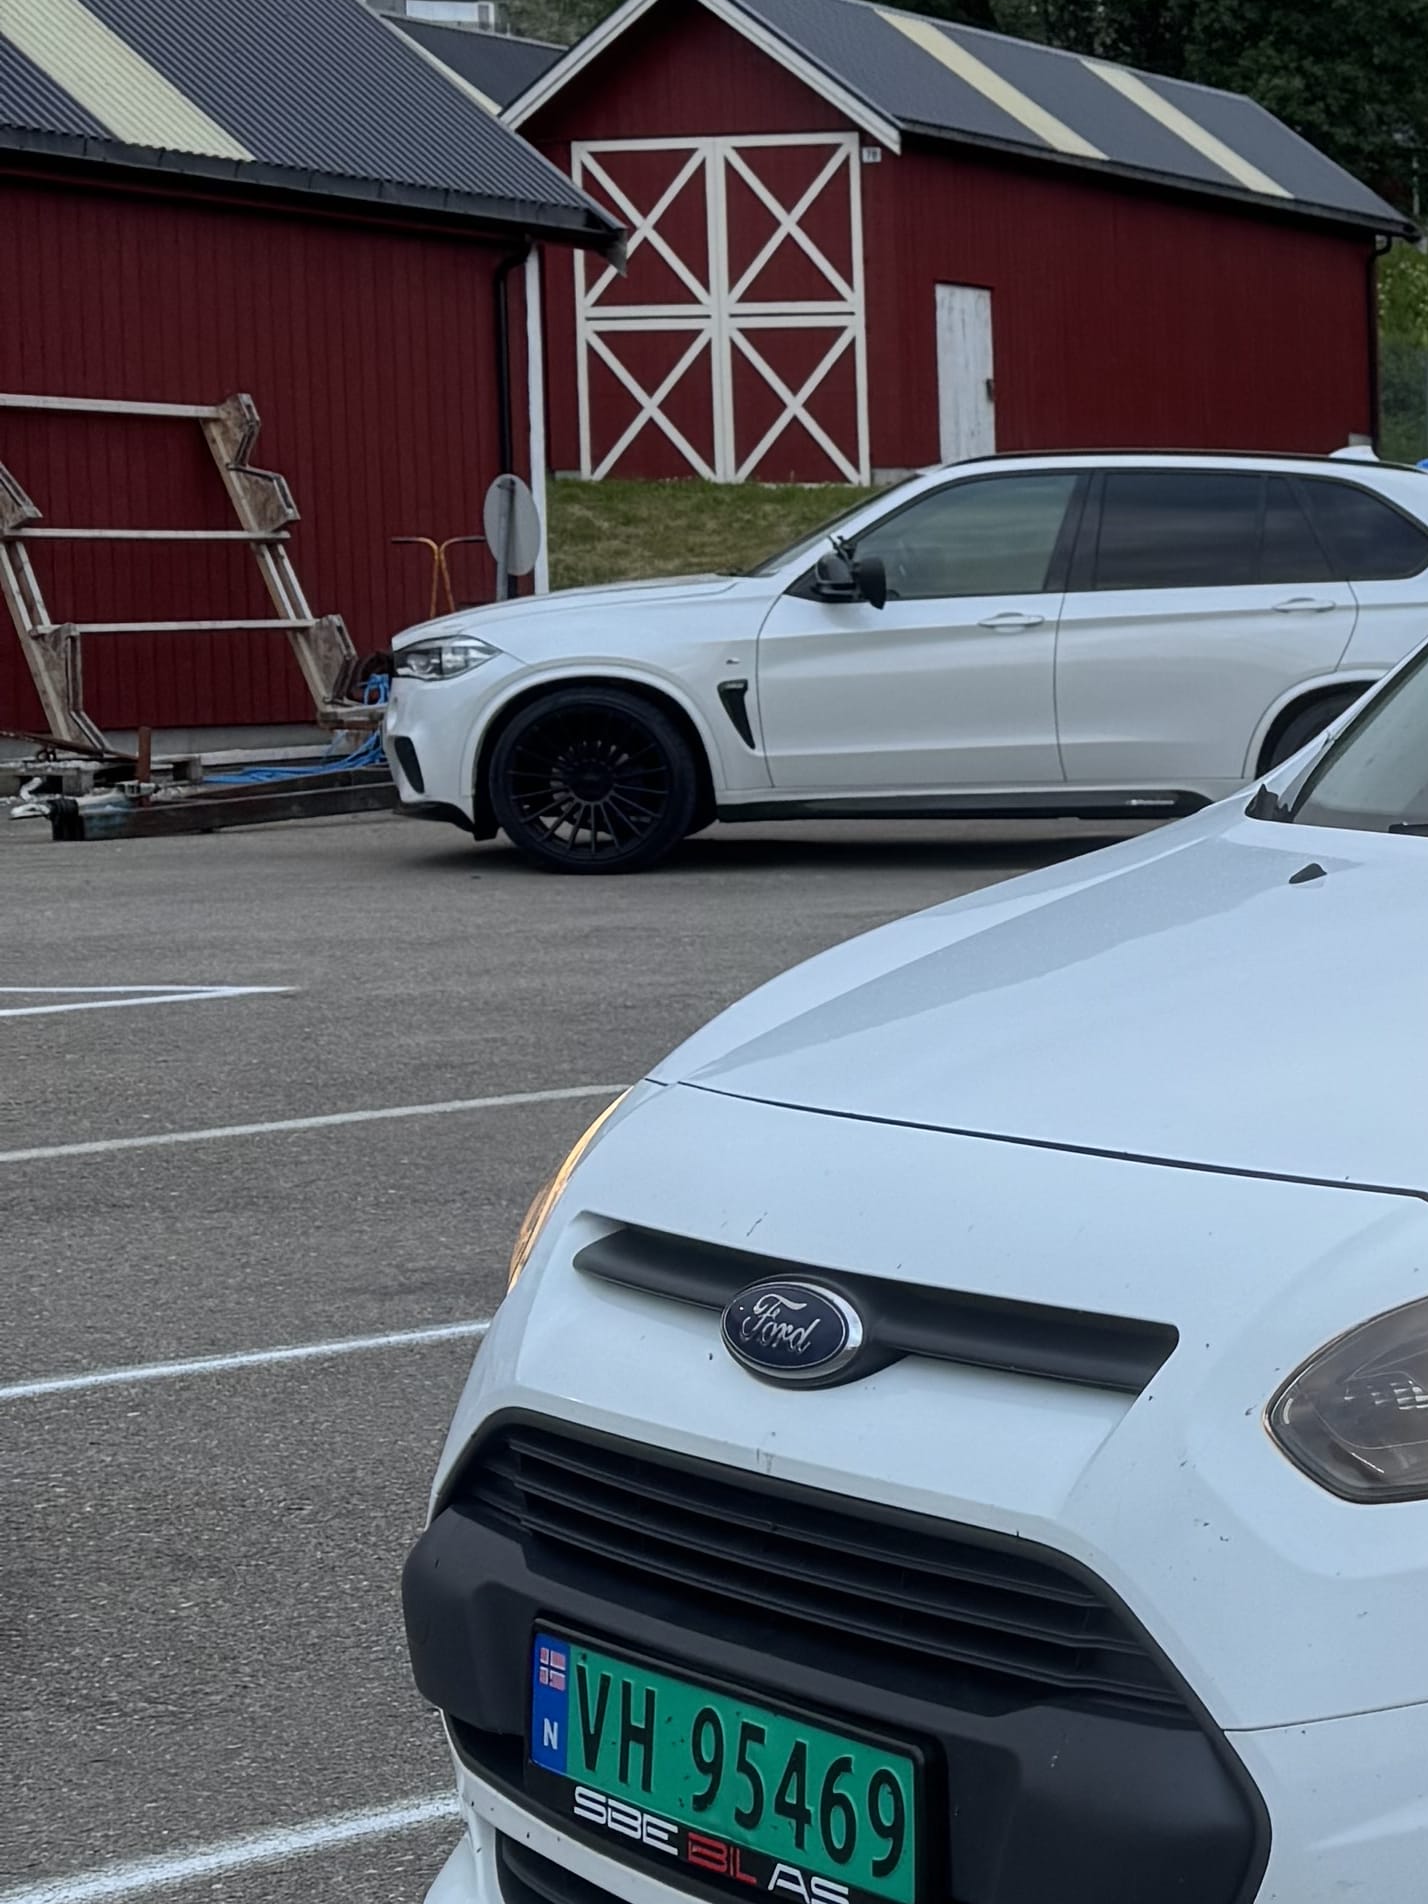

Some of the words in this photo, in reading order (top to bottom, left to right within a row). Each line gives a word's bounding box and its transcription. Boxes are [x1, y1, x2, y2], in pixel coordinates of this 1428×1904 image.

[739, 1293, 821, 1354] Ford
[542, 1717, 559, 1751] N
[576, 1663, 656, 1793] VH
[691, 1707, 905, 1879] 95469
[573, 1785, 679, 1856] SBE
[687, 1831, 757, 1885] BIL
